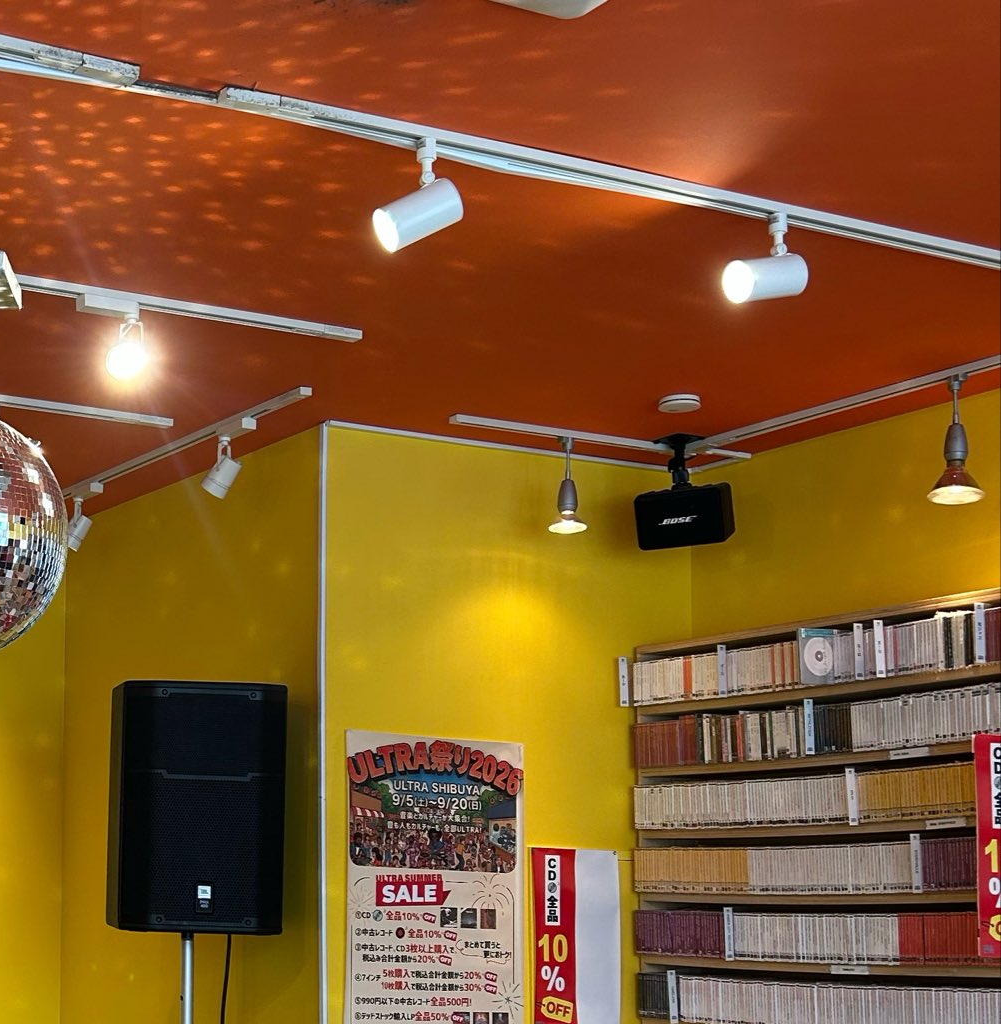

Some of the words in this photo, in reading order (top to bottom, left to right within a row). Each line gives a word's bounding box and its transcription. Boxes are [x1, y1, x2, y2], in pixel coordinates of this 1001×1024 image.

[658, 515, 697, 525] BOSE
[347, 740, 524, 796] ULTRA祭り2026
[394, 780, 429, 793] ULTRA
[432, 782, 481, 796] SHIBUYA
[376, 874, 404, 882] ULTRA
[405, 873, 443, 882] SUMMER
[382, 884, 437, 903] SALE
[538, 933, 569, 963] 10
[541, 965, 566, 992] %
[546, 1001, 571, 1018] OFF
